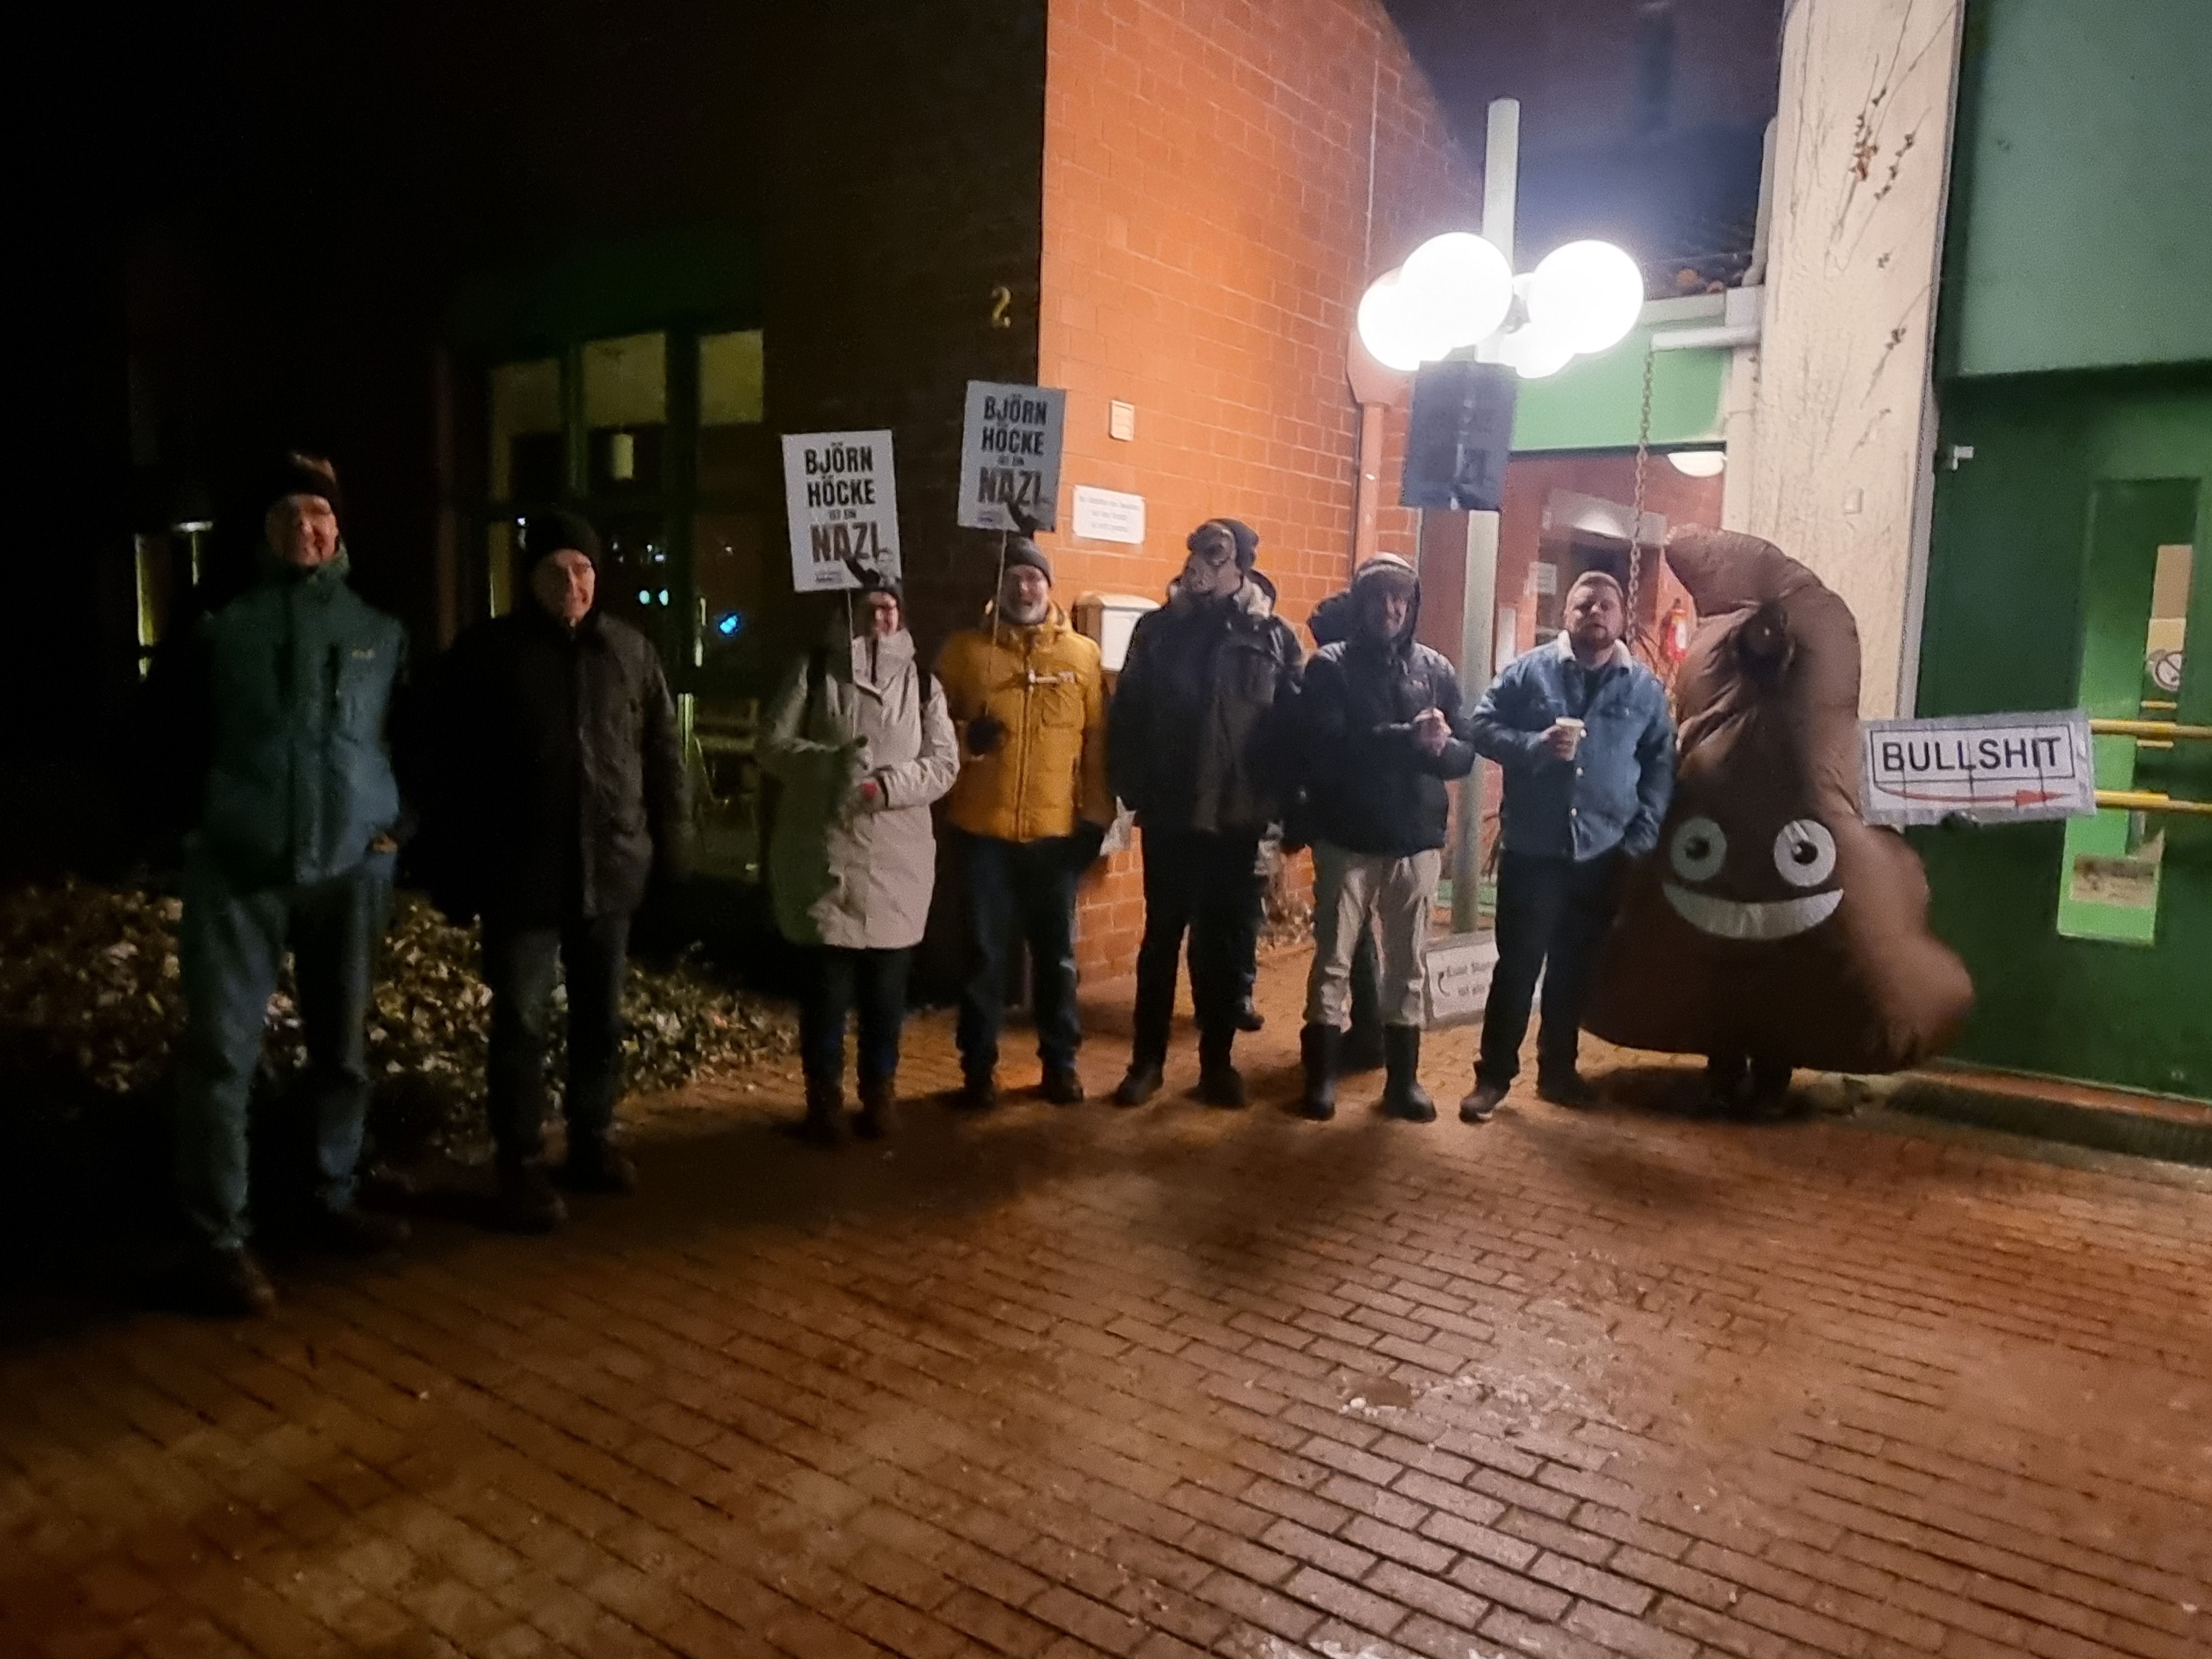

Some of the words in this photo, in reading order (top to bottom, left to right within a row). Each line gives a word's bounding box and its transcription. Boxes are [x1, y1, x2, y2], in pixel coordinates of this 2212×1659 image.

[991, 287, 1011, 328] 2
[984, 394, 1048, 426] BJÖRN
[981, 421, 1045, 456] HÖCKE
[804, 441, 873, 475] BJÖRN
[807, 475, 876, 507] HÖCKE
[978, 467, 1042, 504] NAZI
[810, 521, 879, 563] NAZI
[1882, 737, 2062, 771] BULLSHIT
